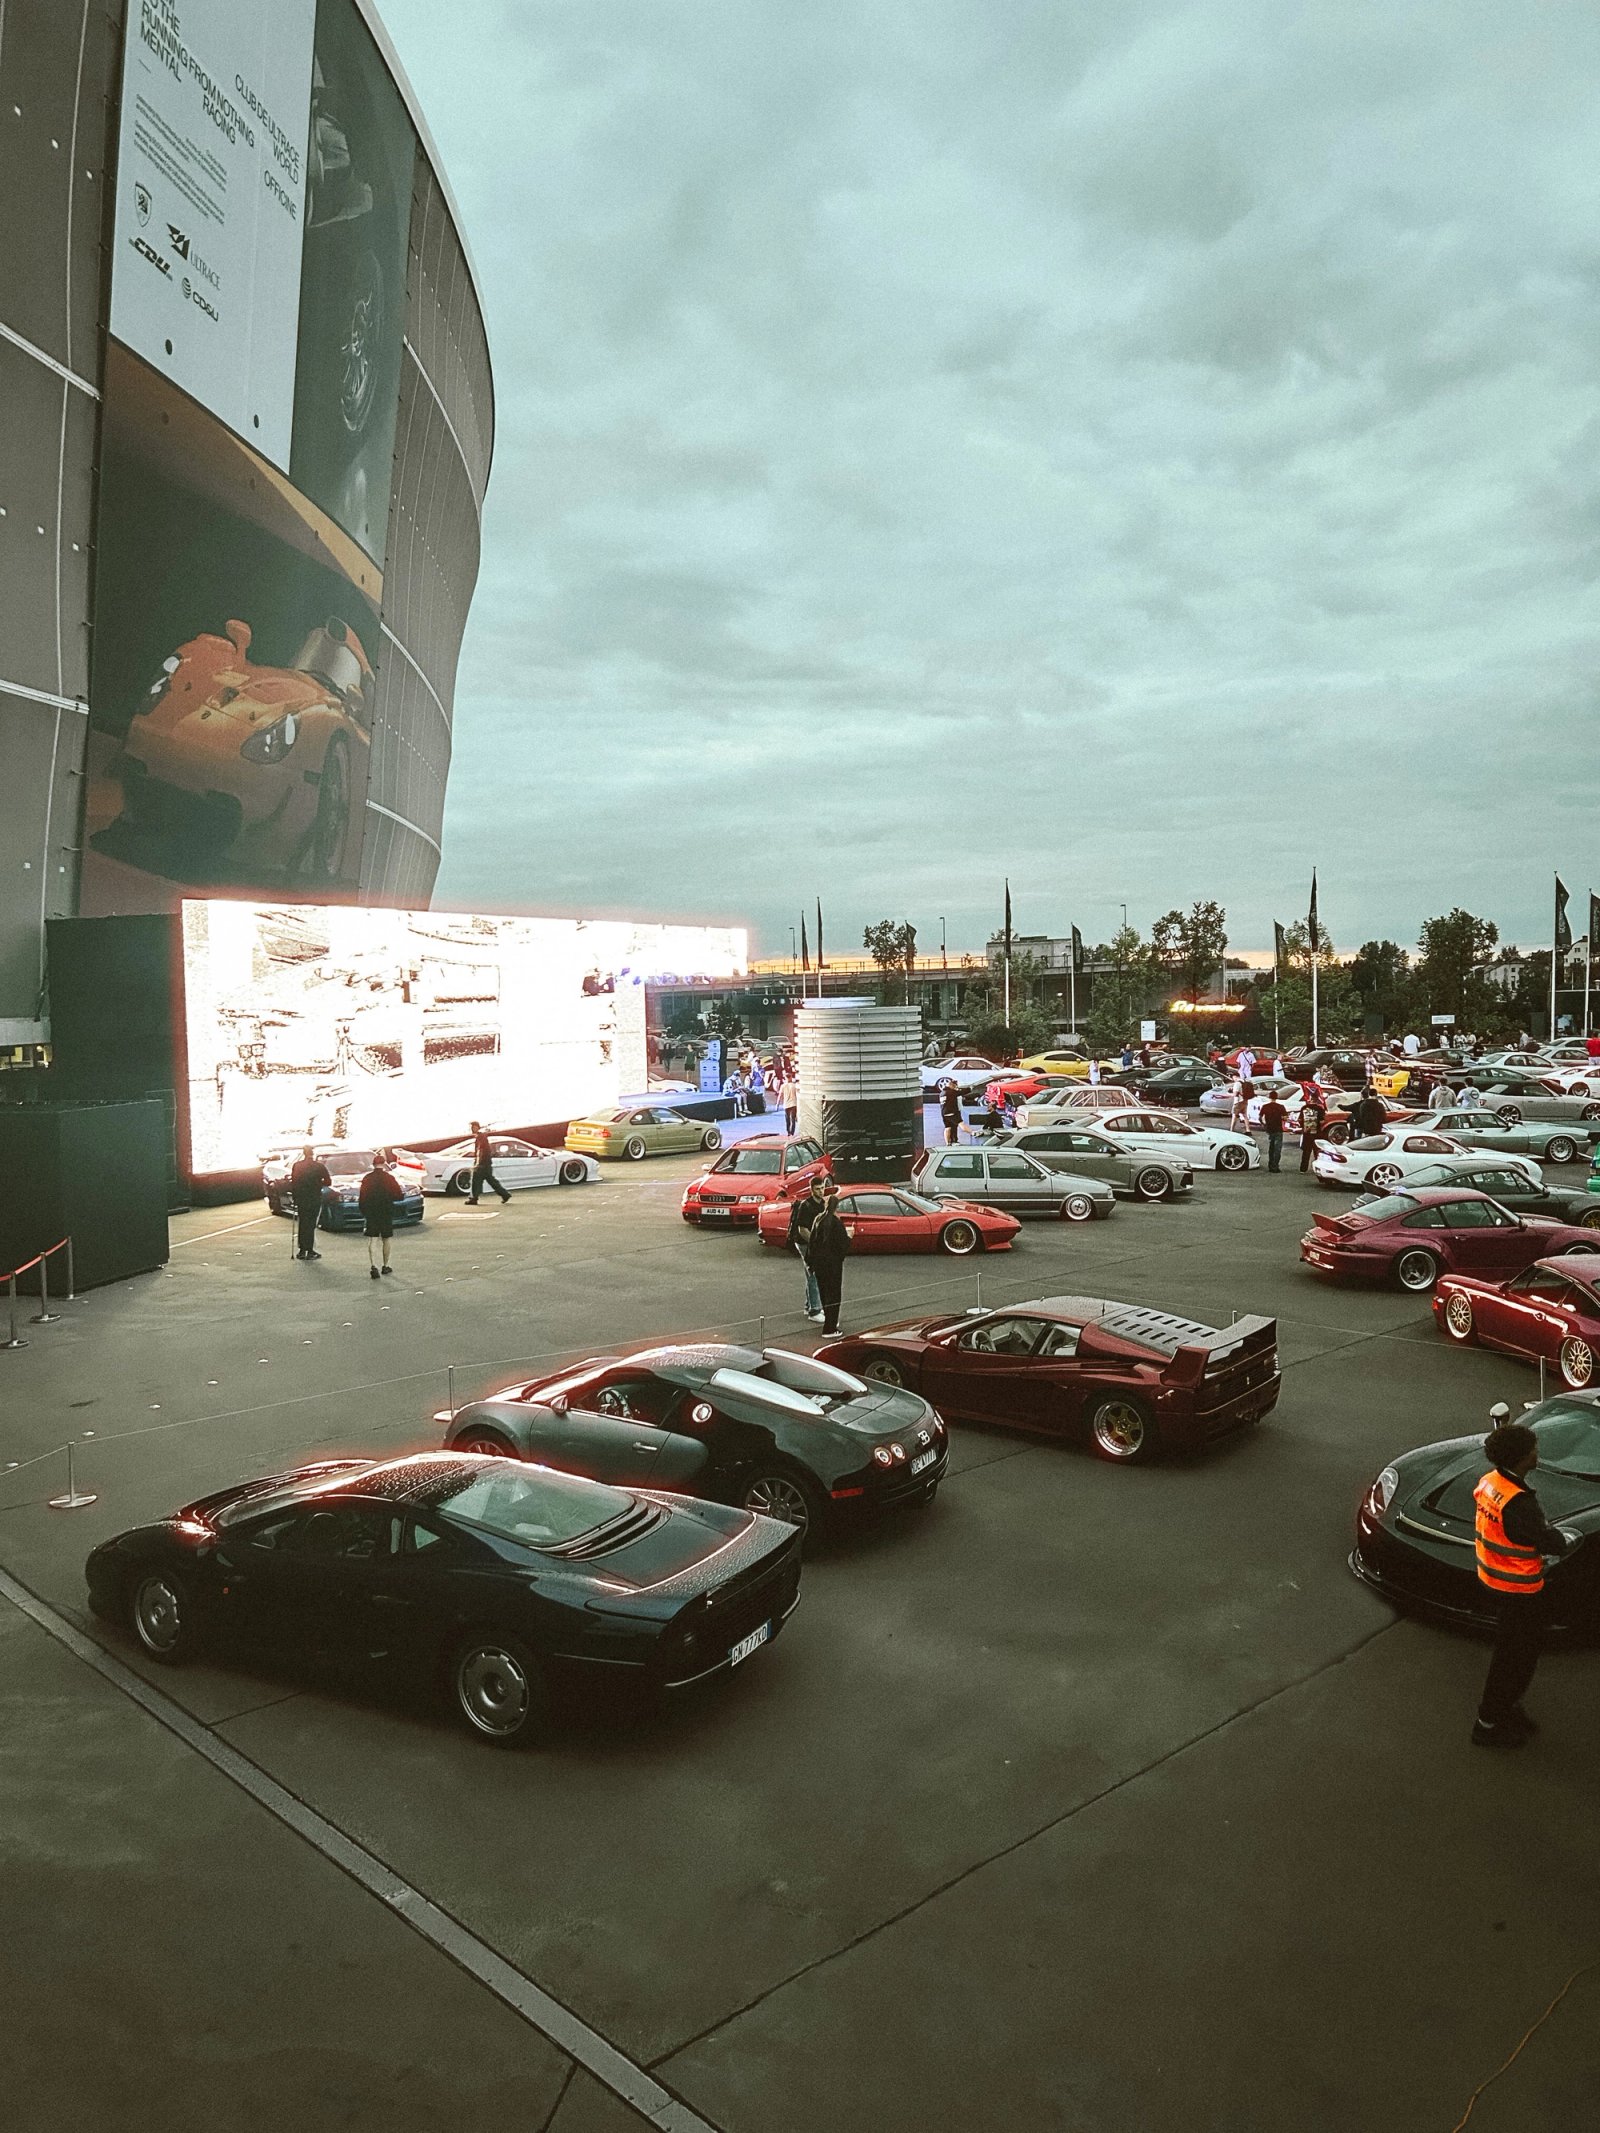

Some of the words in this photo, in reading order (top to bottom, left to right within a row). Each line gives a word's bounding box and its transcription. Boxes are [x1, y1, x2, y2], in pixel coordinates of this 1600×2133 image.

[160, 0, 180, 37] THE
[141, 20, 181, 83] MENTAL
[142, 0, 188, 68] RUNNING
[189, 56, 216, 101] FROM
[217, 90, 254, 148] NOTHING
[203, 94, 236, 145] RACING
[235, 73, 256, 112] CLUB
[257, 101, 268, 128] DE
[268, 115, 299, 169] ULTRACE
[273, 140, 299, 184] WORLD
